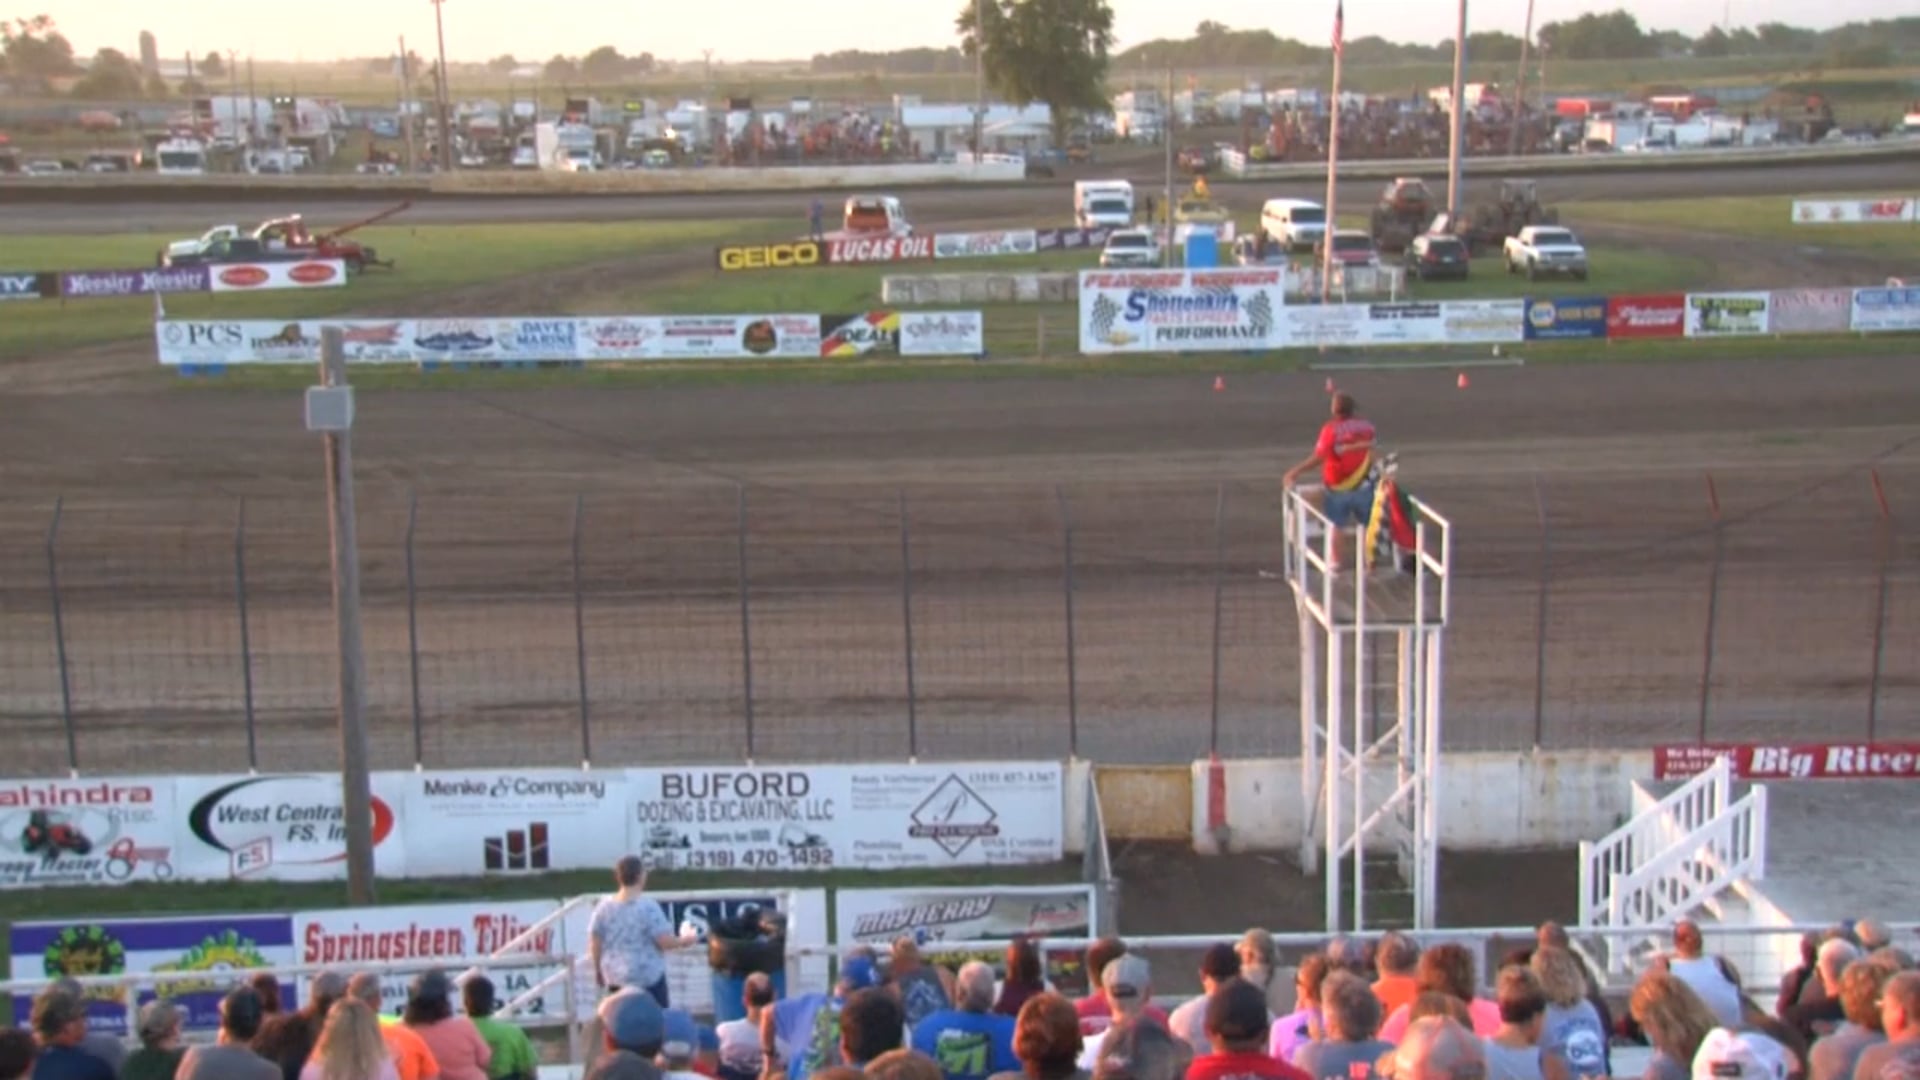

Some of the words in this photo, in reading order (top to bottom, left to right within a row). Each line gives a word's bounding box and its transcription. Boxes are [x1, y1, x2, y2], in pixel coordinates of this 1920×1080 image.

[720, 244, 819, 270] GEICO
[830, 240, 895, 263] LUCAS
[899, 236, 930, 257] OIL
[1085, 273, 1184, 288] FEATURE
[1124, 289, 1239, 322] Shottenkirk
[188, 323, 243, 346] PCS
[516, 333, 576, 346] MARINE
[1156, 324, 1267, 341] PERFORMANCE
[1751, 747, 1813, 776] Big
[424, 777, 487, 796] Menke
[490, 775, 509, 798] &
[514, 776, 606, 799] Company
[661, 772, 810, 799] BUFORD
[217, 806, 269, 824] West
[275, 804, 345, 821] Centra
[637, 801, 693, 823] DOZING
[696, 801, 707, 823] &
[709, 799, 803, 822] EXCAVATING,
[806, 799, 834, 821] LLC
[286, 824, 321, 844] FS,
[237, 849, 264, 869] FS
[687, 849, 735, 867] (319)
[741, 848, 834, 867] 470-1492
[853, 895, 995, 936] MAYBERRY
[304, 922, 465, 963] Springsteen
[474, 913, 554, 953] Tiling
[504, 974, 530, 990] IA
